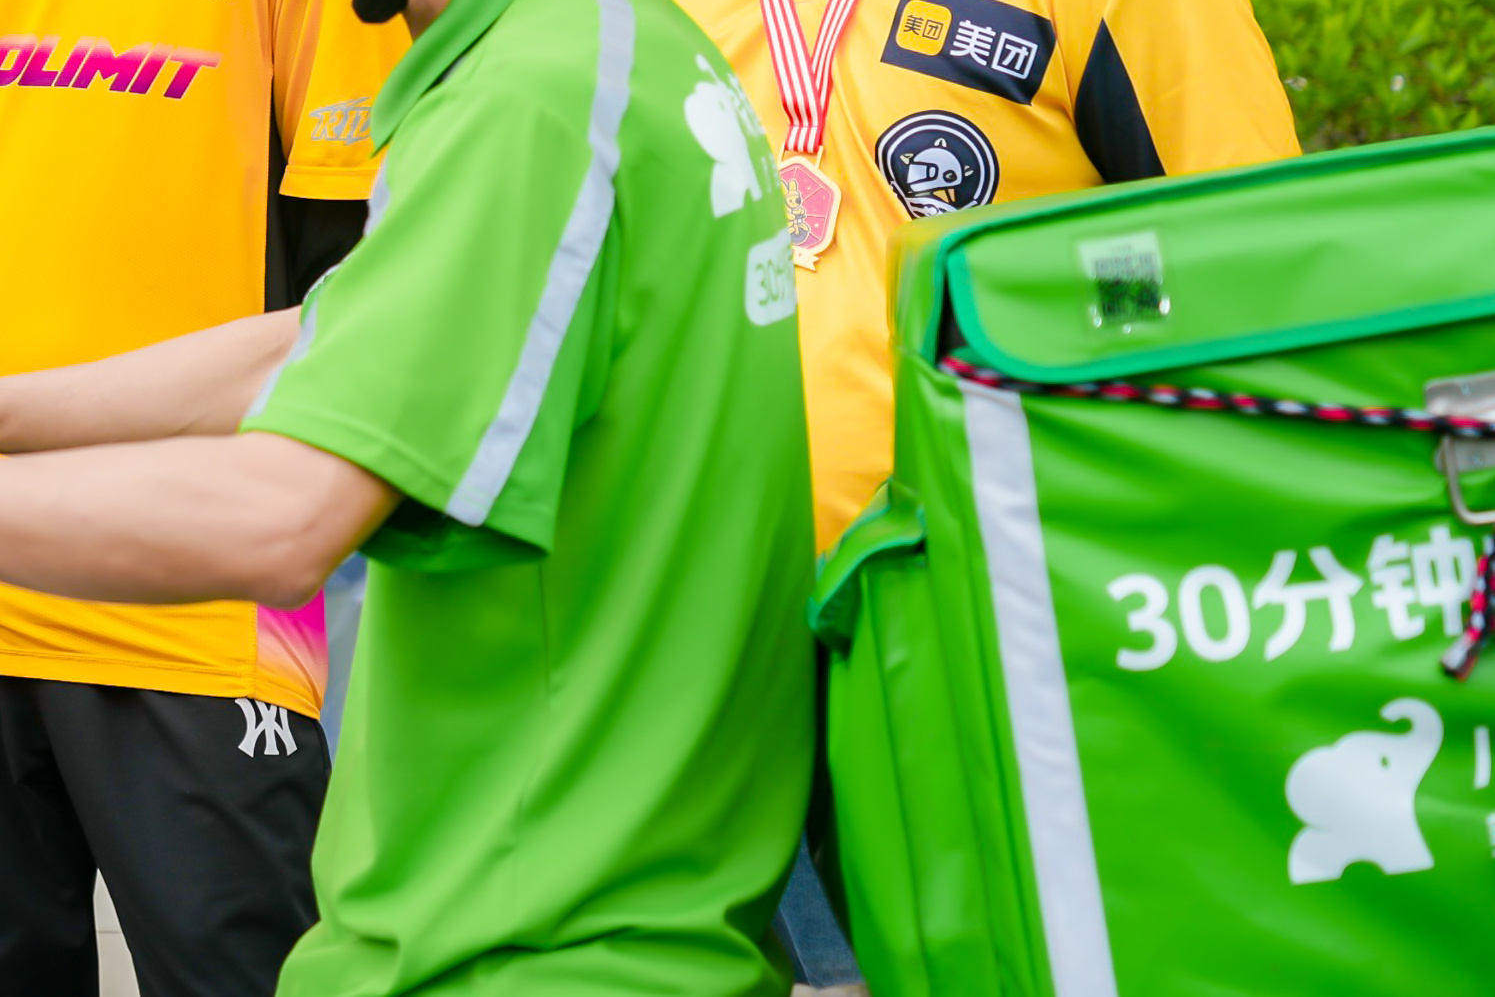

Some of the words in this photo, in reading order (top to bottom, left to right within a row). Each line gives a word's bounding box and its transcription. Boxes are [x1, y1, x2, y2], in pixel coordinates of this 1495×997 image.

[903, 14, 944, 41] 美团
[950, 19, 1039, 80] 美团
[1107, 525, 1491, 672] 30分钟
